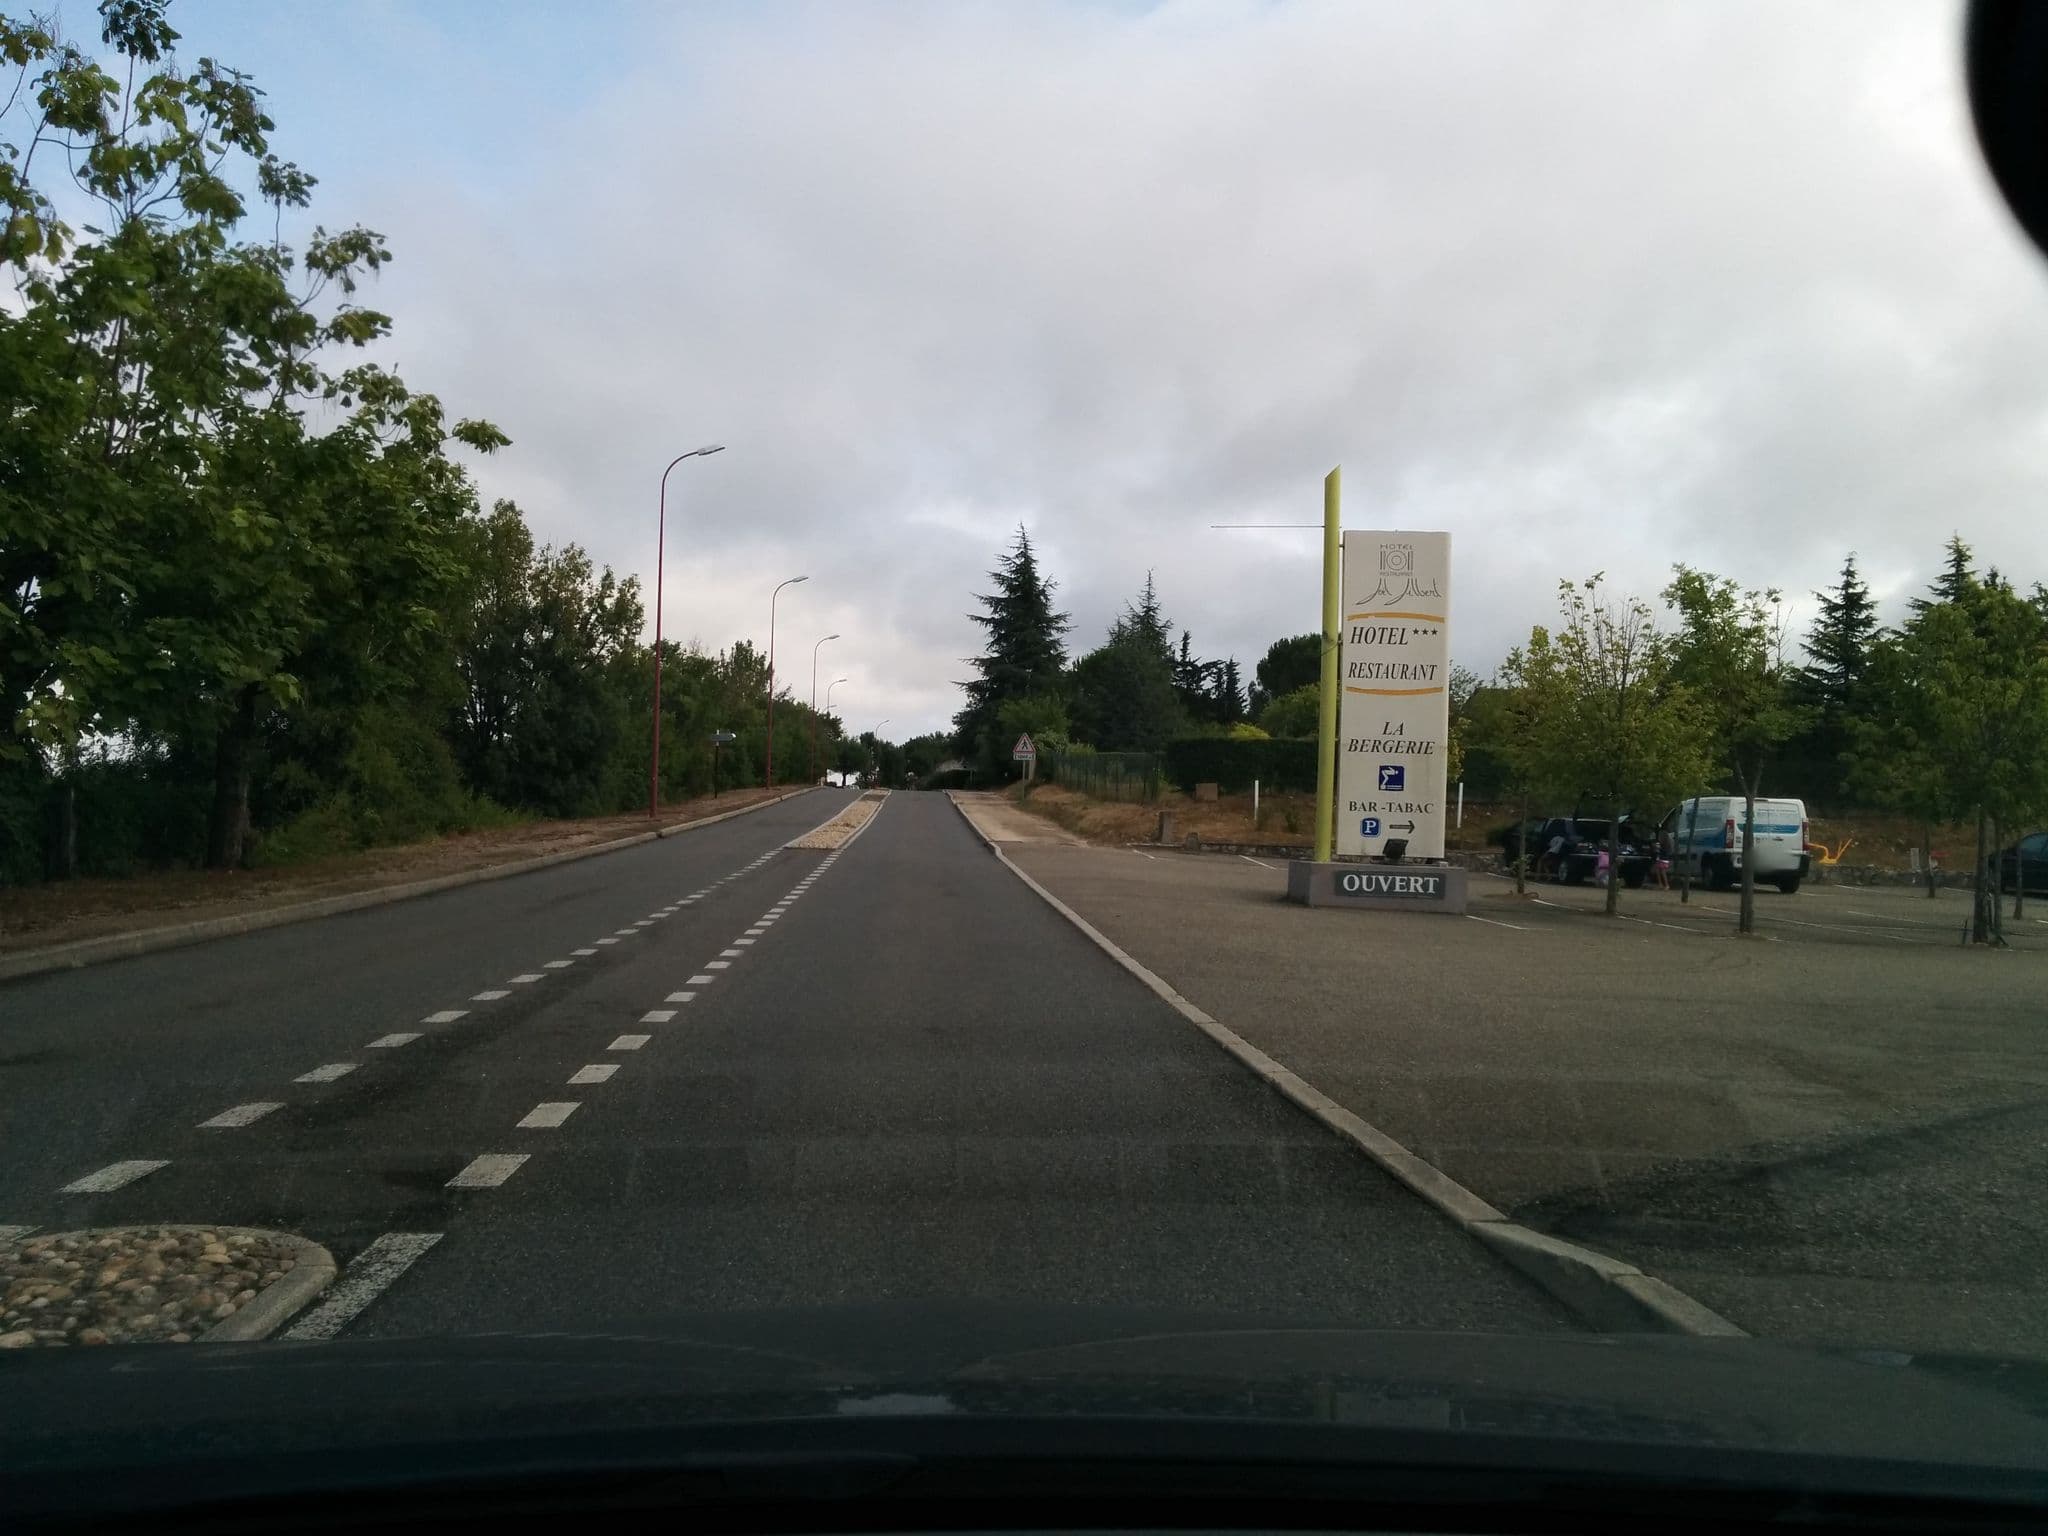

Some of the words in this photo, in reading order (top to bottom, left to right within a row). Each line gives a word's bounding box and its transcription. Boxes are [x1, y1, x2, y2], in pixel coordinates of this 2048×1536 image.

[1350, 626, 1409, 646] HOTEL
[1348, 662, 1438, 681] RESTAURANT
[1382, 721, 1405, 736] LA
[1348, 738, 1436, 755] BERGERIE
[1364, 820, 1377, 834] P
[1342, 874, 1440, 894] OUVERT
